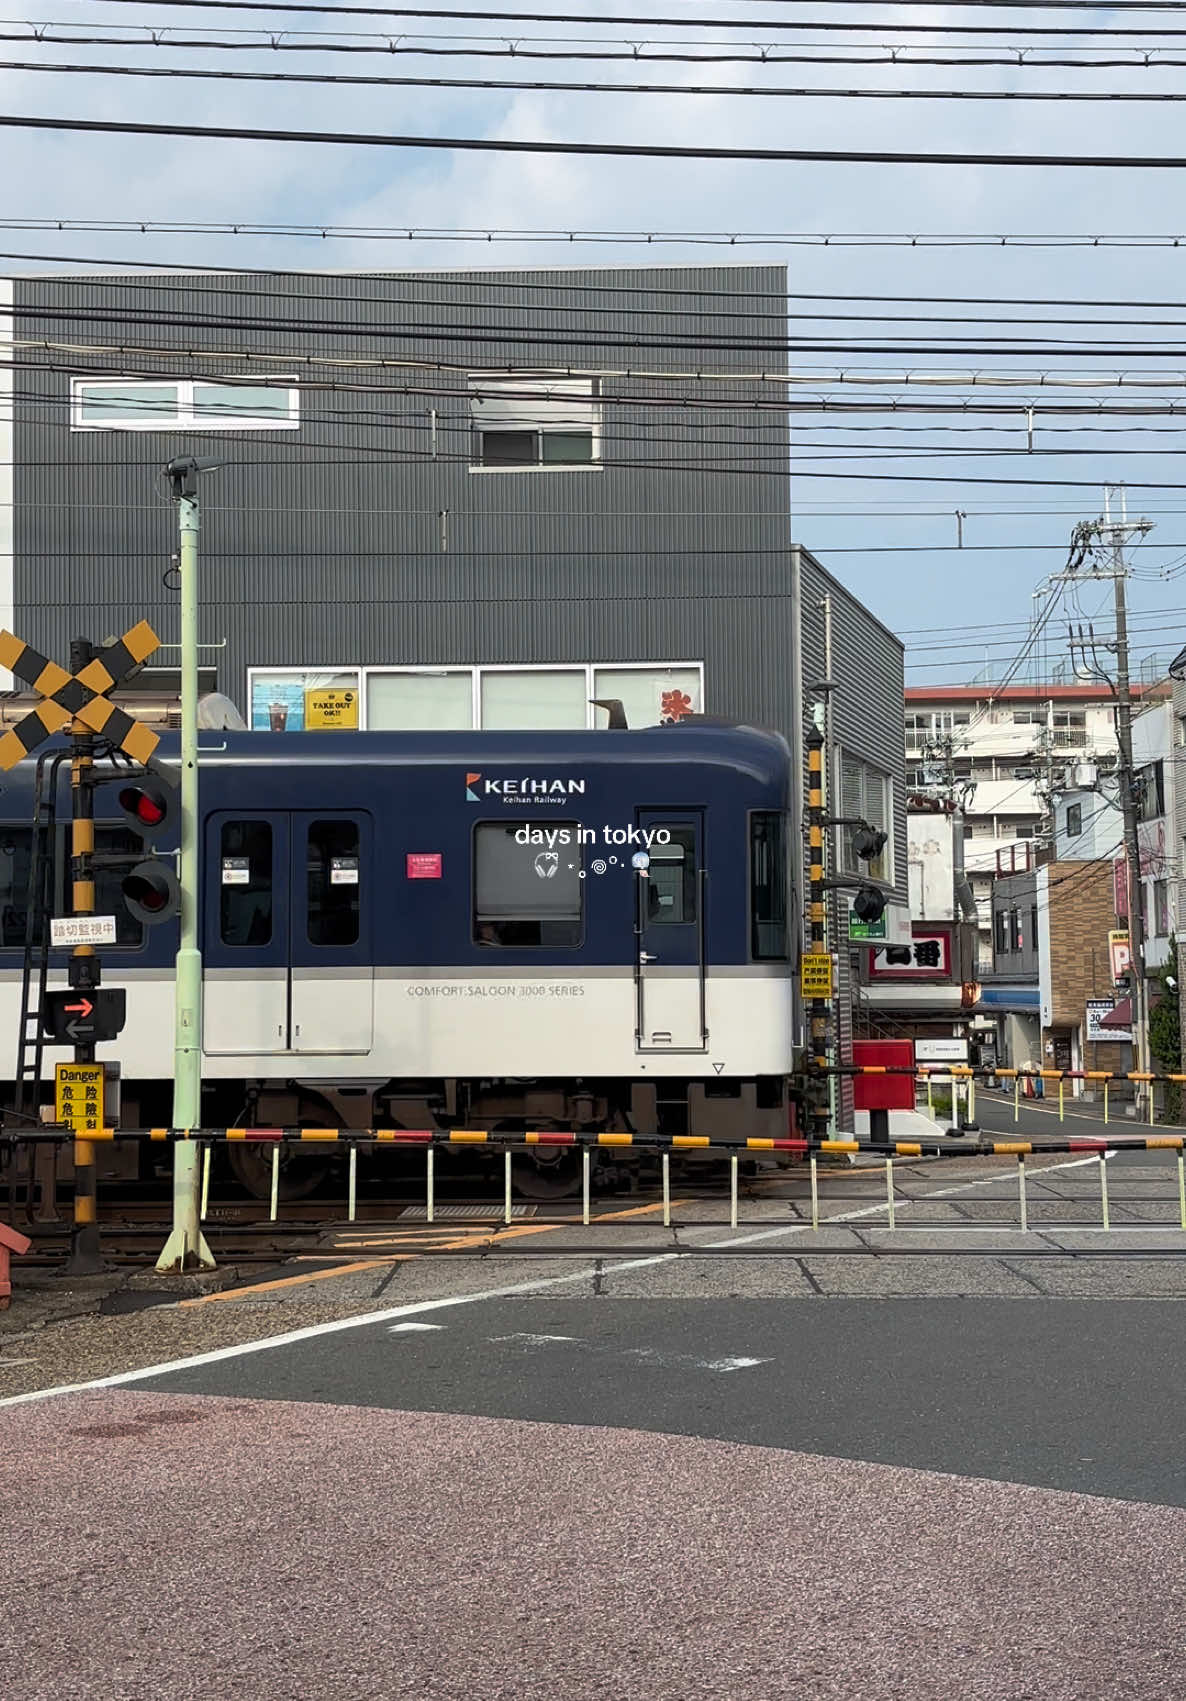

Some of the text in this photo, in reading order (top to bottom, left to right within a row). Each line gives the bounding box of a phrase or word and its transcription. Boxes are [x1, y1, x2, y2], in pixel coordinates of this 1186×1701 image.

[313, 702, 351, 710] TAKE OUT
[485, 777, 585, 794] KEIHAN
[503, 796, 567, 806] Keihan Railway
[407, 986, 585, 997] COMFORT SALOON 3000 SERIES
[60, 1069, 100, 1083] Danger
